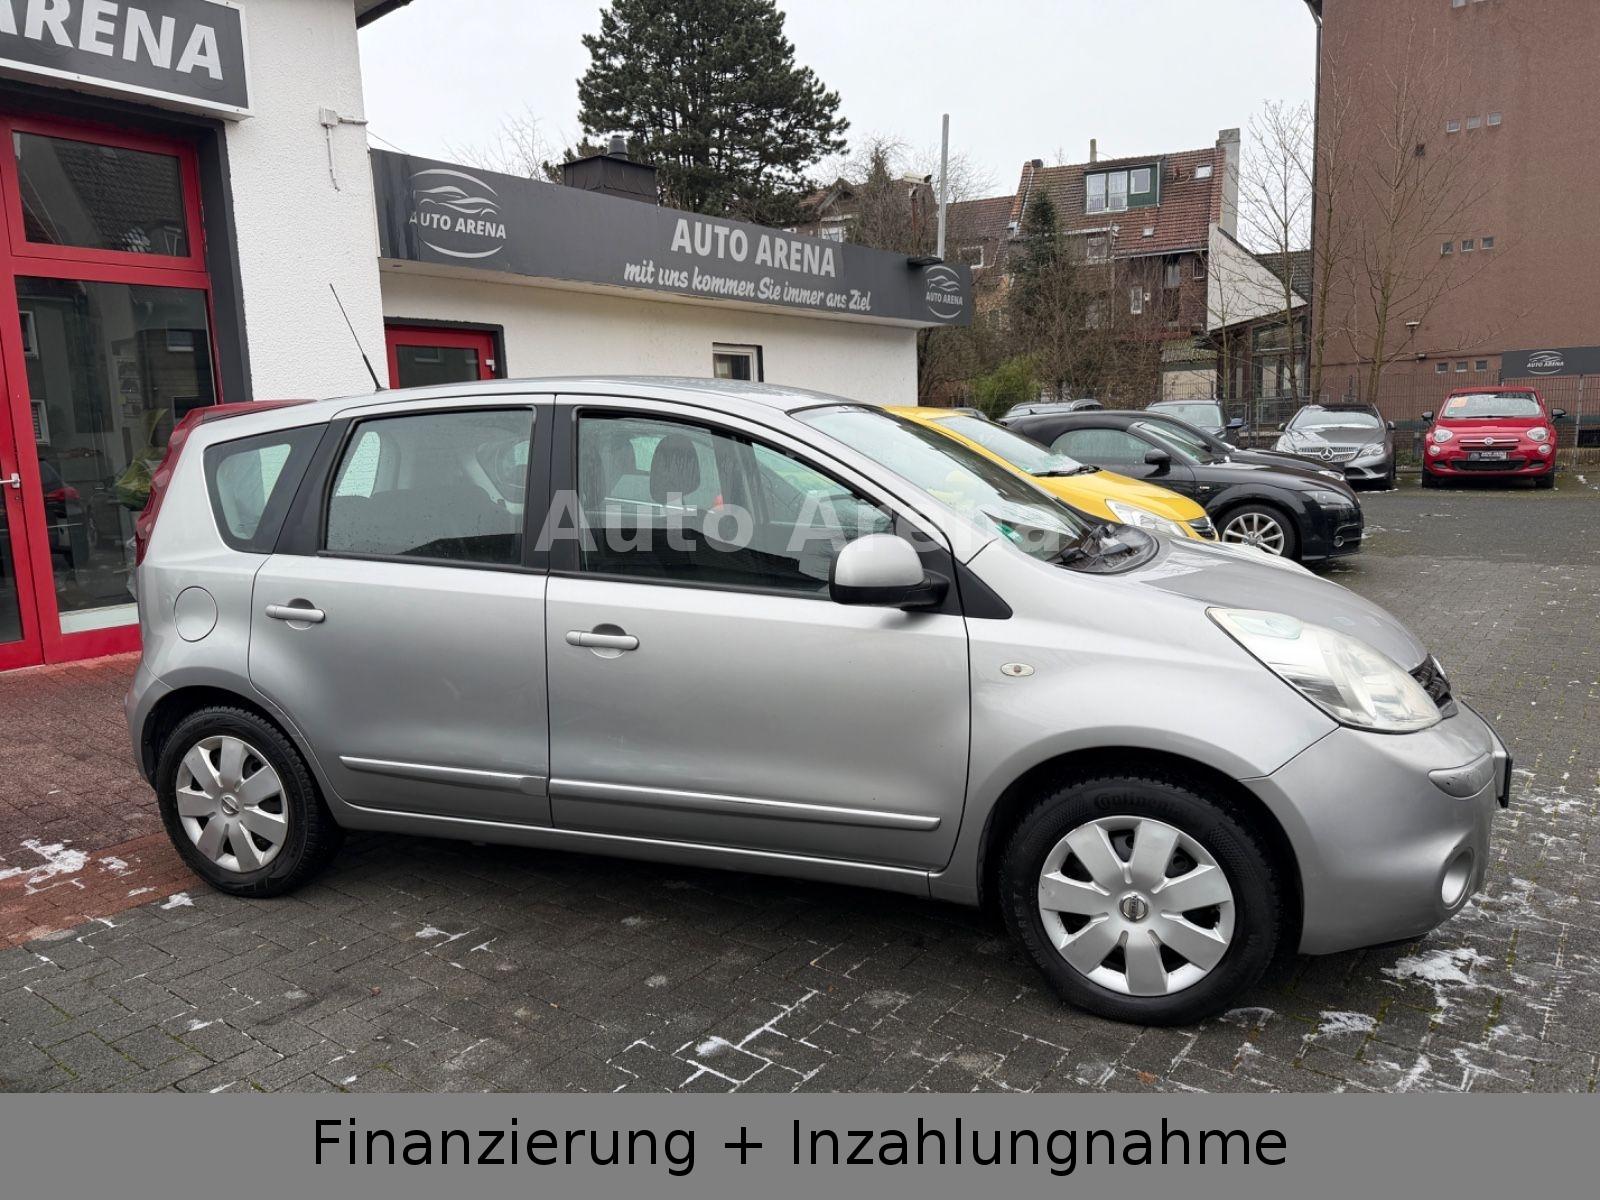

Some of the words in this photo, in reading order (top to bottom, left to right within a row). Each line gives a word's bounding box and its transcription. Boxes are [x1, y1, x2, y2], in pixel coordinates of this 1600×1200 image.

[408, 211, 452, 231] AUTO
[454, 217, 507, 239] ARENA
[671, 218, 749, 262] AUTO
[754, 234, 836, 278] ARENA
[623, 260, 655, 284] mit
[658, 267, 689, 288] uns
[692, 266, 755, 299] kommen
[756, 277, 781, 300] Sie
[783, 284, 825, 307] immer
[826, 291, 847, 309] ans
[849, 289, 872, 311] Ziel
[926, 291, 941, 303] AUTO
[942, 294, 964, 306] ARENA
